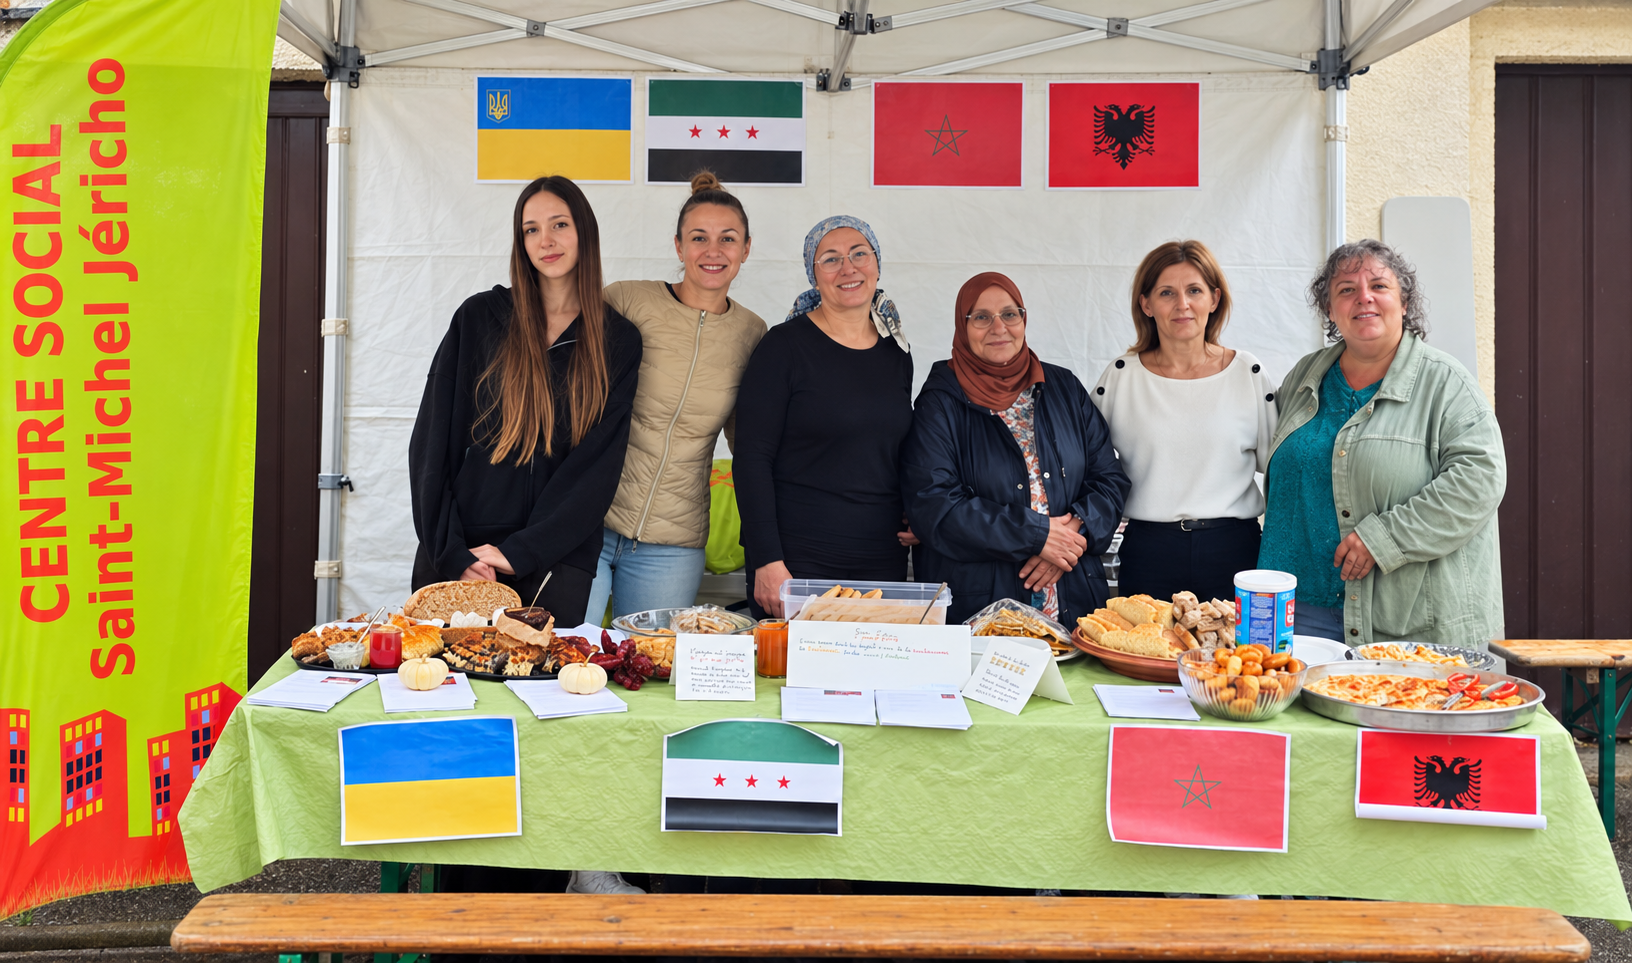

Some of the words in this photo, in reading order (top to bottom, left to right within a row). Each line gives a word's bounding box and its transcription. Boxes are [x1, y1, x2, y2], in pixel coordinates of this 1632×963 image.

[11, 123, 64, 358] SOCIAL
[78, 57, 139, 282] Jéricho
[15, 378, 70, 624] CENTRE
[83, 302, 136, 679] Saint-Michel
